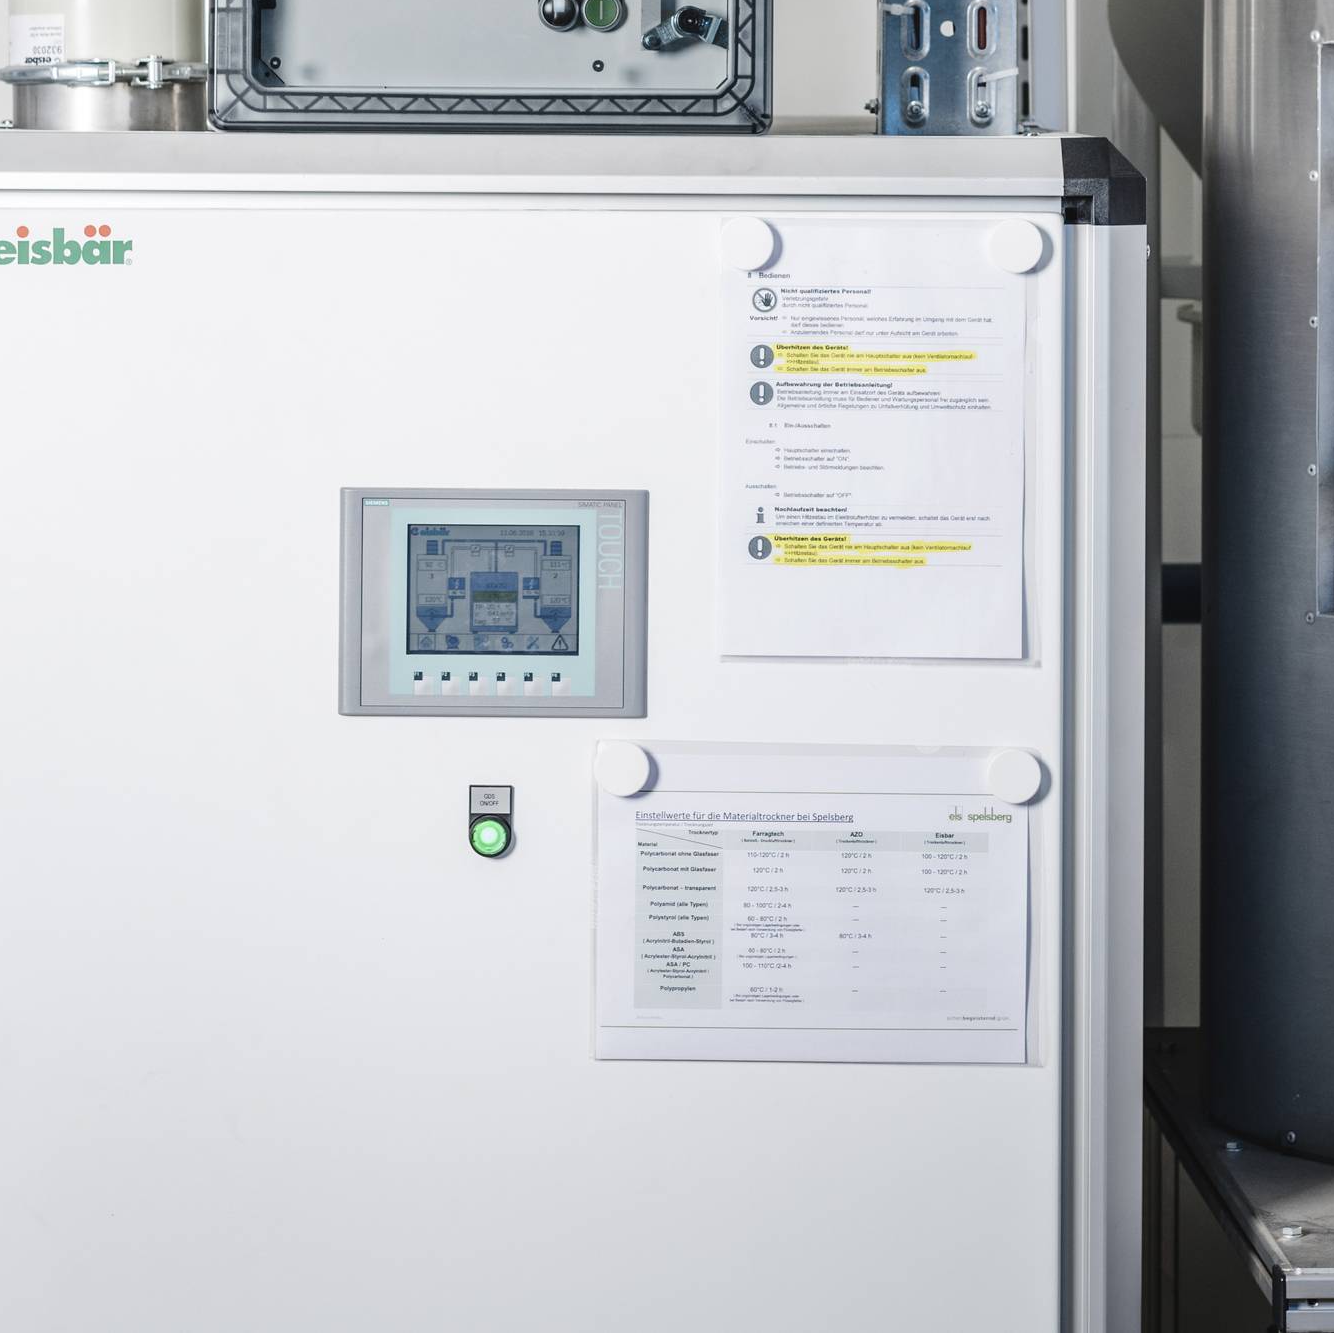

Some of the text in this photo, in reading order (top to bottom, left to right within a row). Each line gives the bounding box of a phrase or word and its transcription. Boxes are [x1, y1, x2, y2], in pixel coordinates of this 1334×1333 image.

[598, 507, 622, 588] TOUCH
[635, 811, 854, 823] Einstellwerte für die Materialtrockner bei Spelsberg
[967, 806, 1012, 823] spelsberg
